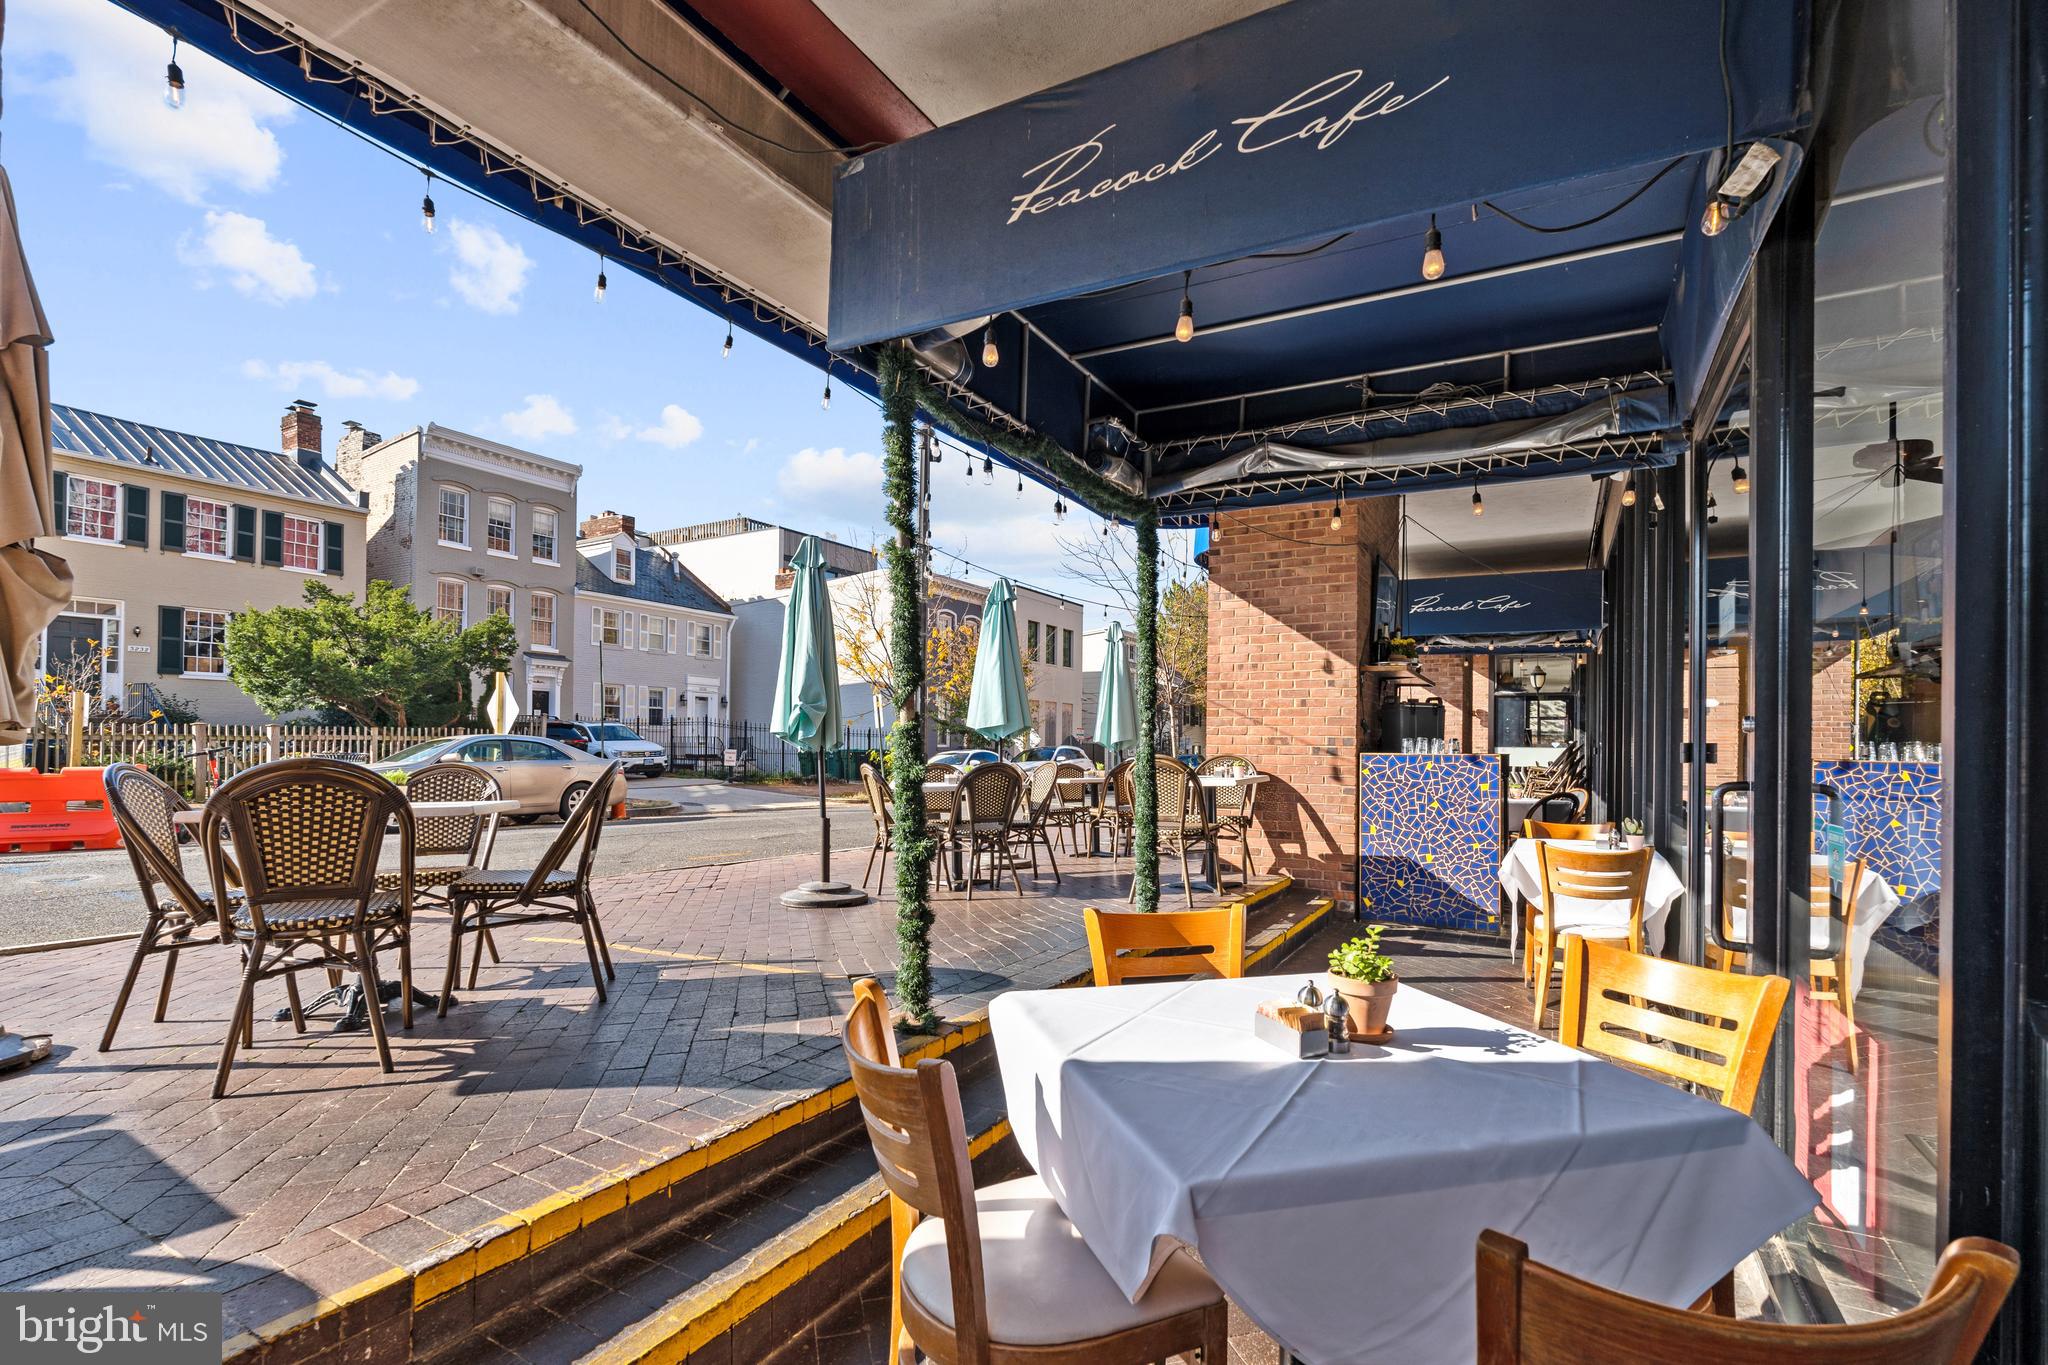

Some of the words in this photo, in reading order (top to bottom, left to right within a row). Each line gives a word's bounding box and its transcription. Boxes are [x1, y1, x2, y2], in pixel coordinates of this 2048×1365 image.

[1006, 123, 1222, 225] Peacock
[1231, 69, 1450, 153] Cafe
[1408, 592, 1474, 614] Peacock
[1476, 594, 1532, 613] Cafe
